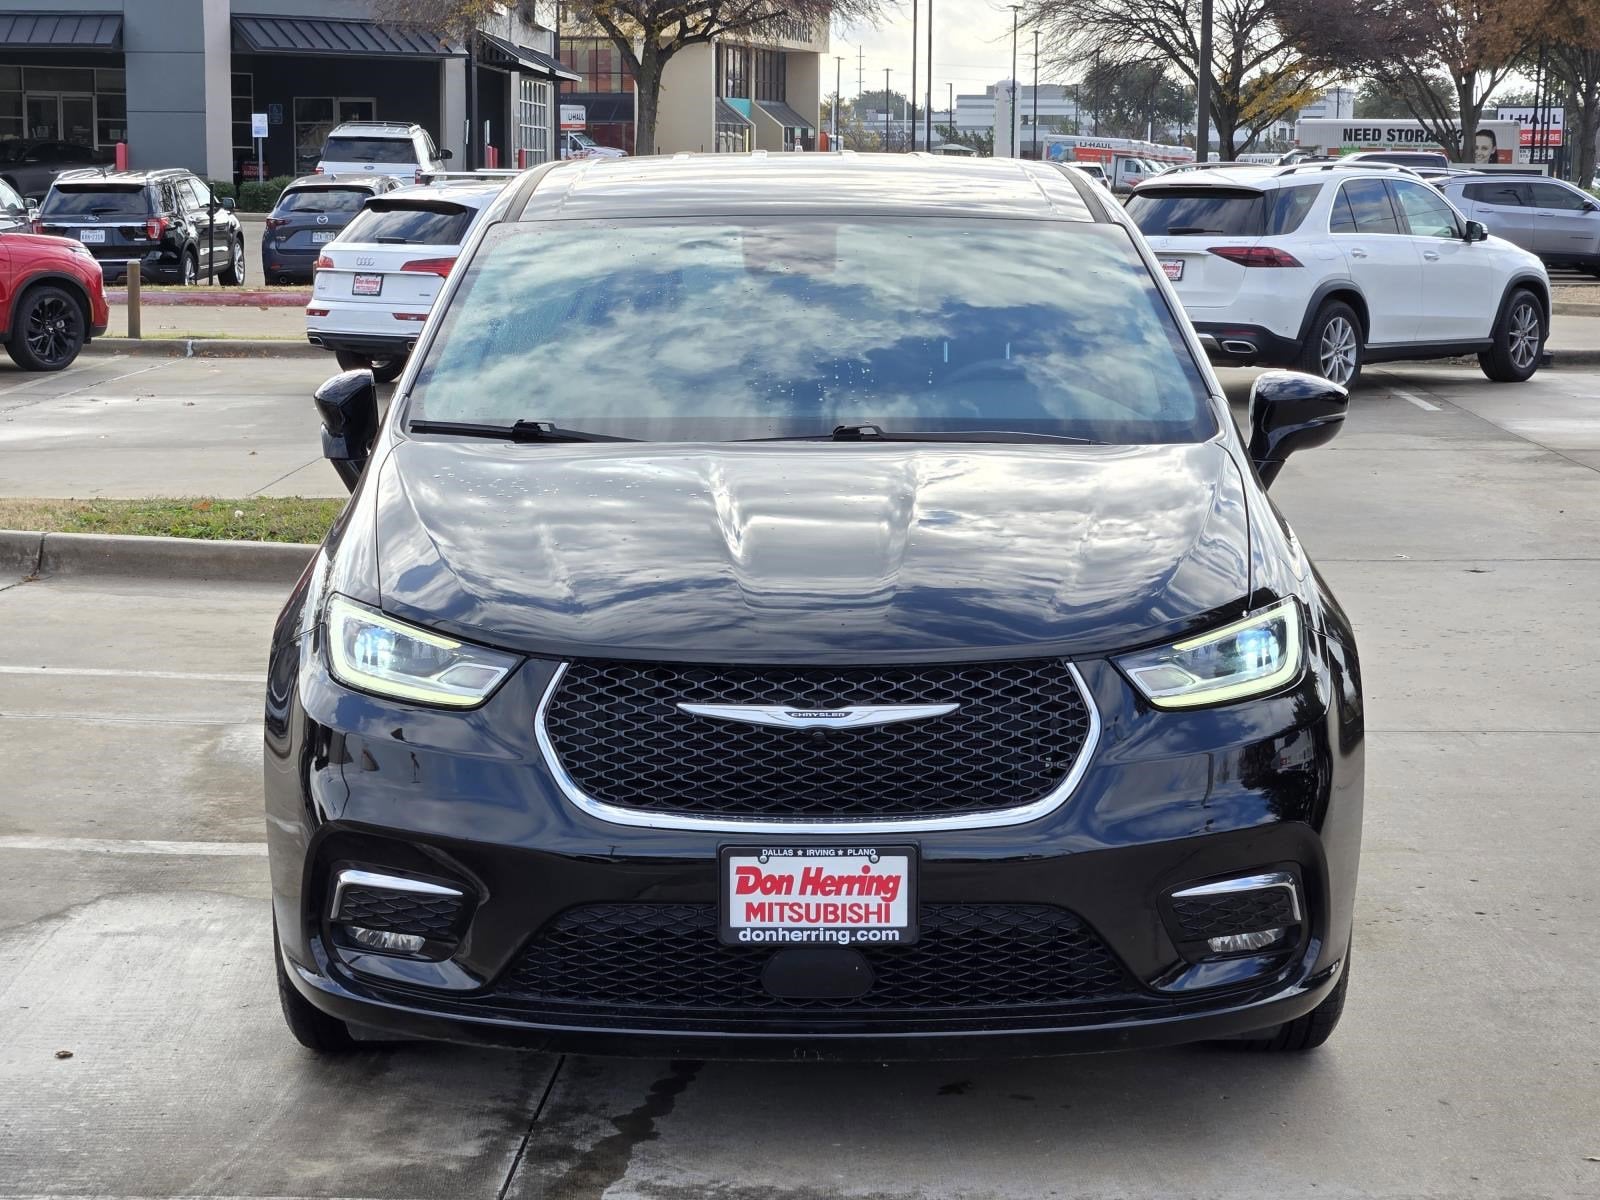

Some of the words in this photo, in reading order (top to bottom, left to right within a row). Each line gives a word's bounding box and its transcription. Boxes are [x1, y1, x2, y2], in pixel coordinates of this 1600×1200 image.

[1342, 128, 1382, 142] NEED
[1386, 128, 1463, 143] STORA?
[735, 866, 795, 896] Don
[798, 865, 902, 903] Herring
[745, 902, 891, 924] MITSUBISHI
[738, 928, 900, 945] donherring.com
